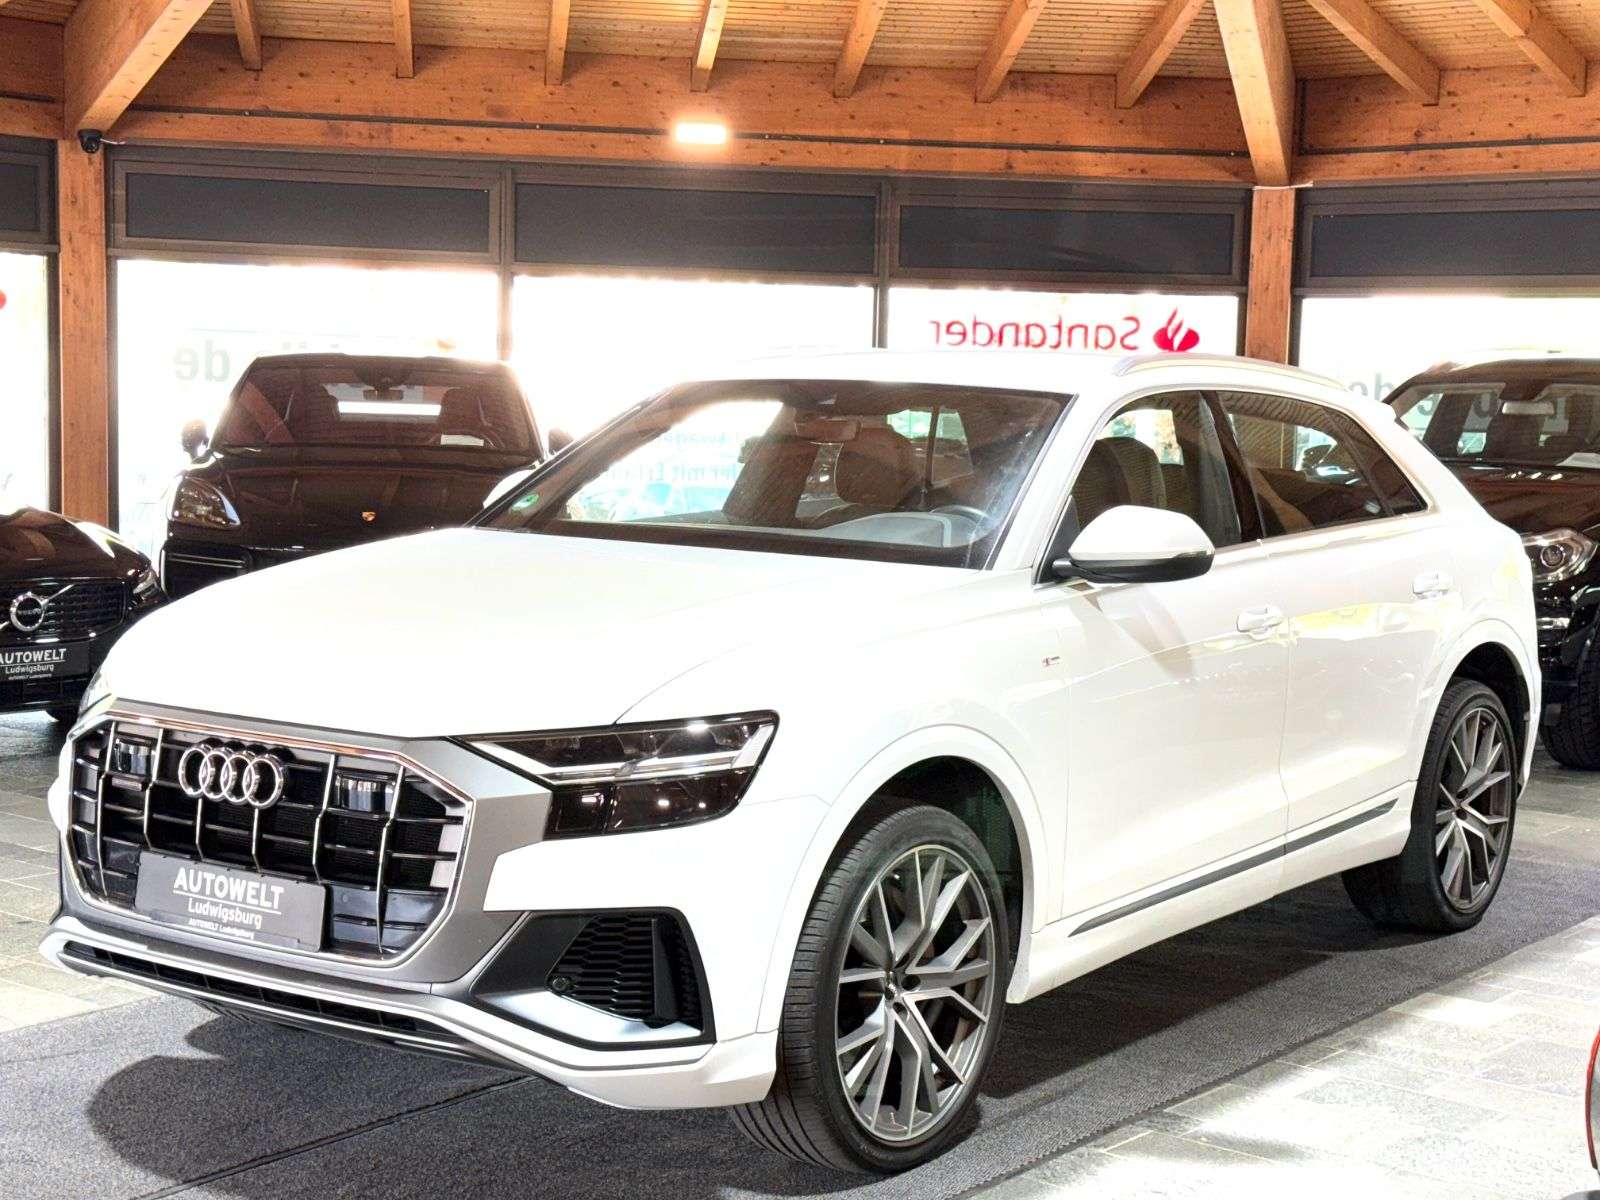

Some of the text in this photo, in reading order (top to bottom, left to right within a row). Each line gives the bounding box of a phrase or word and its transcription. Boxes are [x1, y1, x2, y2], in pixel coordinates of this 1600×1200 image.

[5, 664, 55, 674] Ludwigsburg
[173, 867, 284, 909] AUTOWELT
[188, 897, 263, 930] Ludwigsburg
